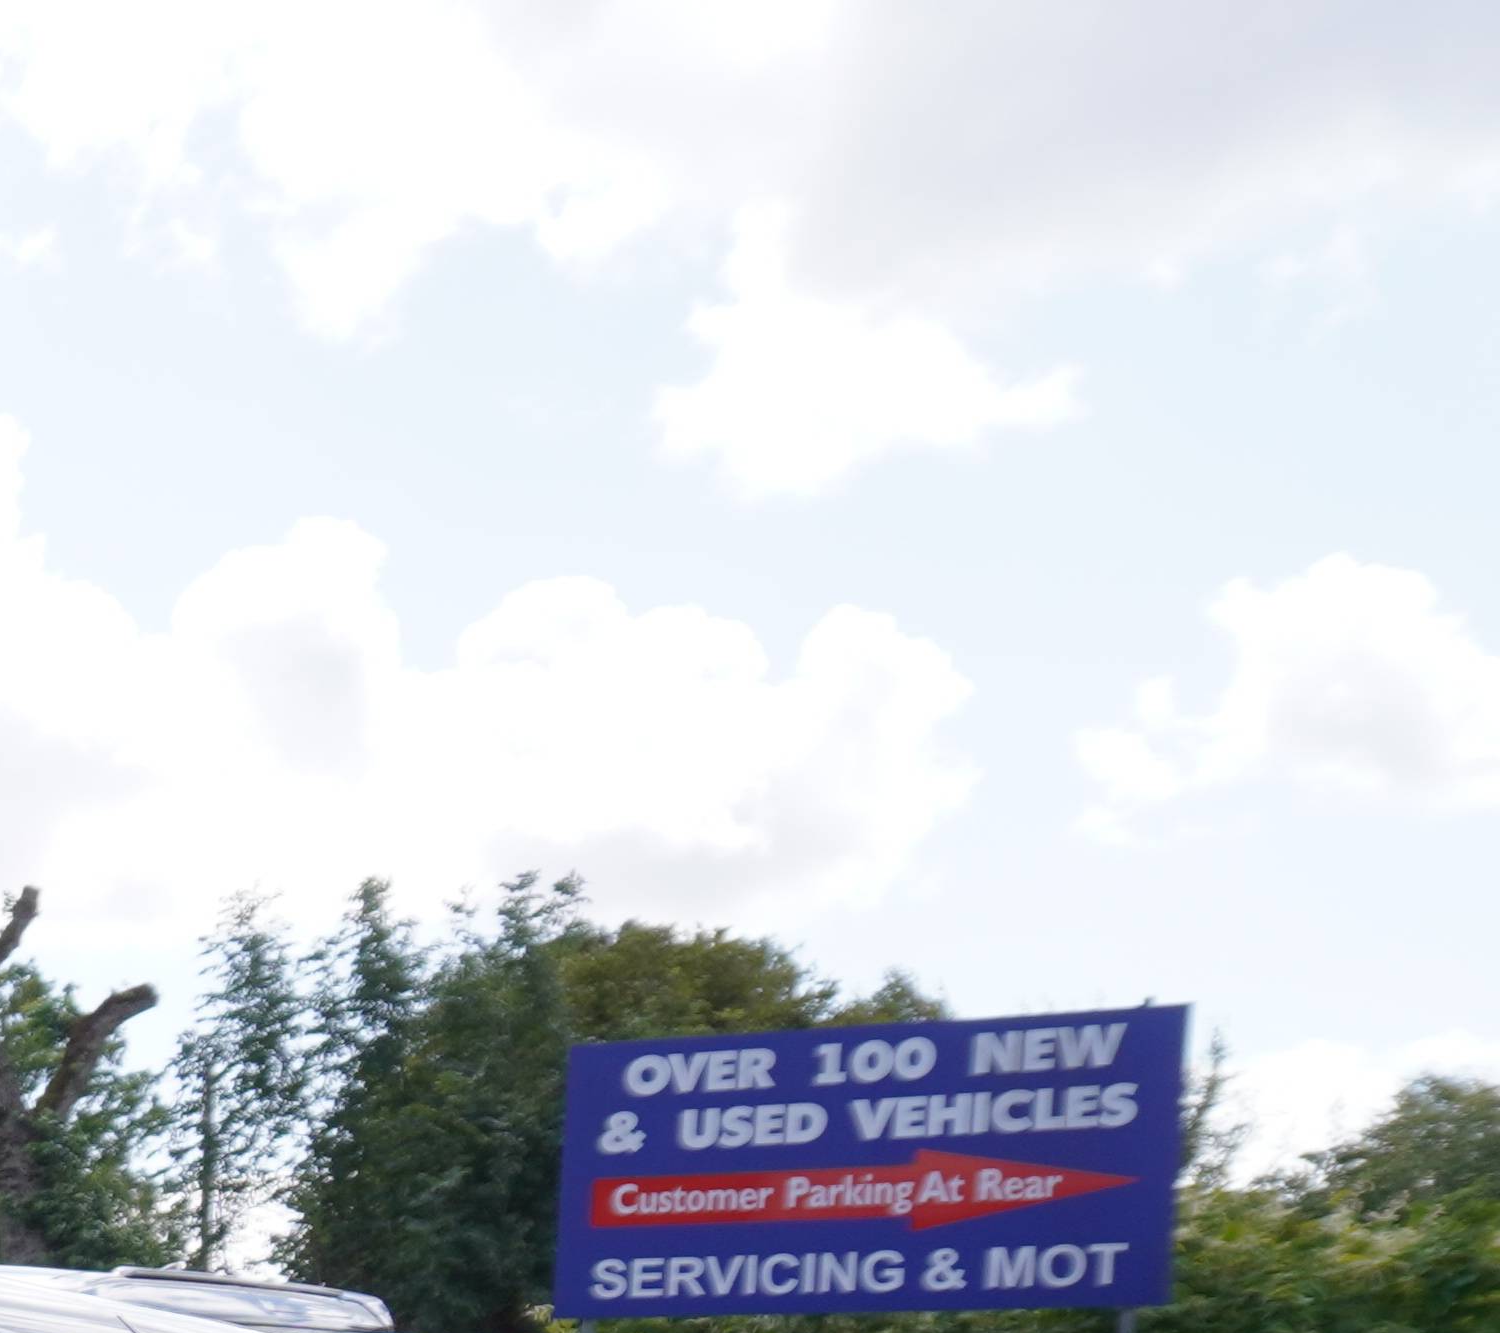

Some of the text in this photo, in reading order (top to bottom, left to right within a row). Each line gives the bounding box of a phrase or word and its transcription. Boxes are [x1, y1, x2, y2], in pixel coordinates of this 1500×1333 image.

[624, 1022, 1128, 1096] OVER 100 NEW
[598, 1082, 1139, 1154] & USED VEHICLES
[610, 1168, 1064, 1215] Customer Parking At Rear
[590, 1242, 1129, 1299] SERVICING & MOT
